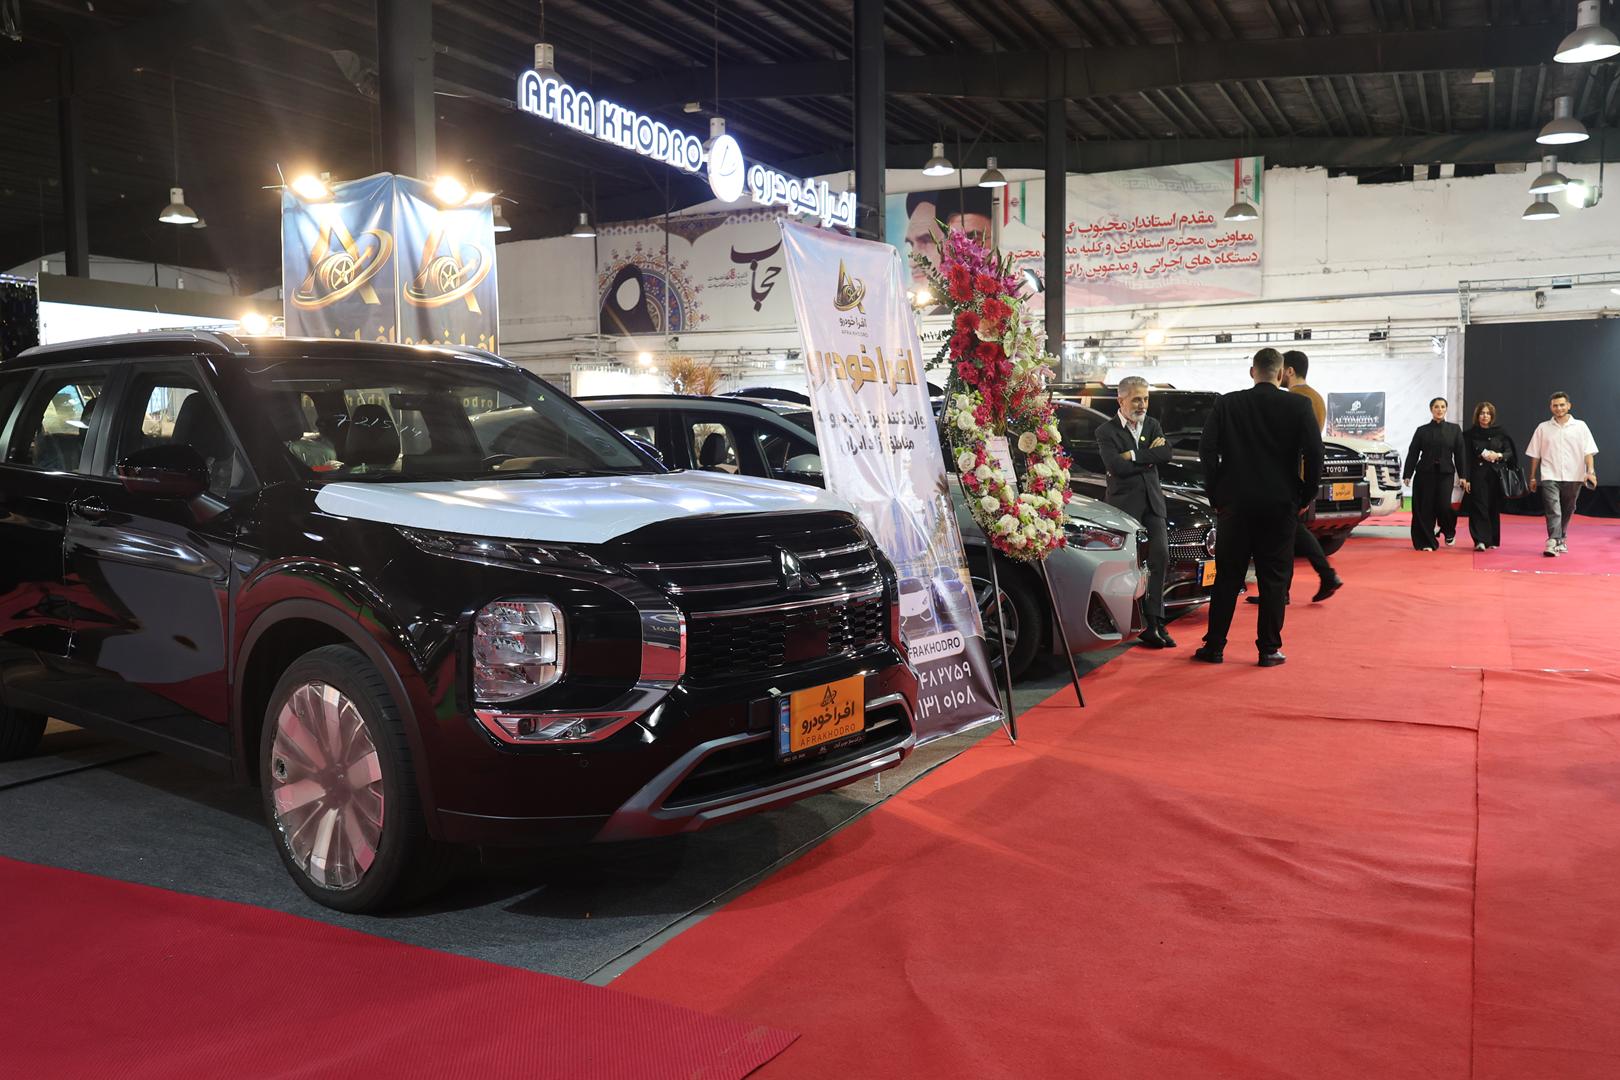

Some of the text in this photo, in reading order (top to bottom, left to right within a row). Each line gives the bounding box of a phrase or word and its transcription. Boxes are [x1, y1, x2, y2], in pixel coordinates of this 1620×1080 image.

[518, 70, 703, 173] AFRA KHODRO
[1078, 220, 1127, 238] محبوب
[1128, 213, 1176, 233] استاندار
[1179, 211, 1214, 230] مقدم
[1114, 236, 1164, 254] استانداری
[1167, 237, 1204, 251] محترم
[1207, 230, 1254, 249] معاونین
[1105, 243, 1112, 255] و
[1215, 250, 1258, 264] دستگاه
[1132, 261, 1138, 273] و
[1185, 254, 1212, 269] های
[908, 637, 960, 659] FRAKHODRO
[800, 723, 856, 747] AFRAKHODRO
